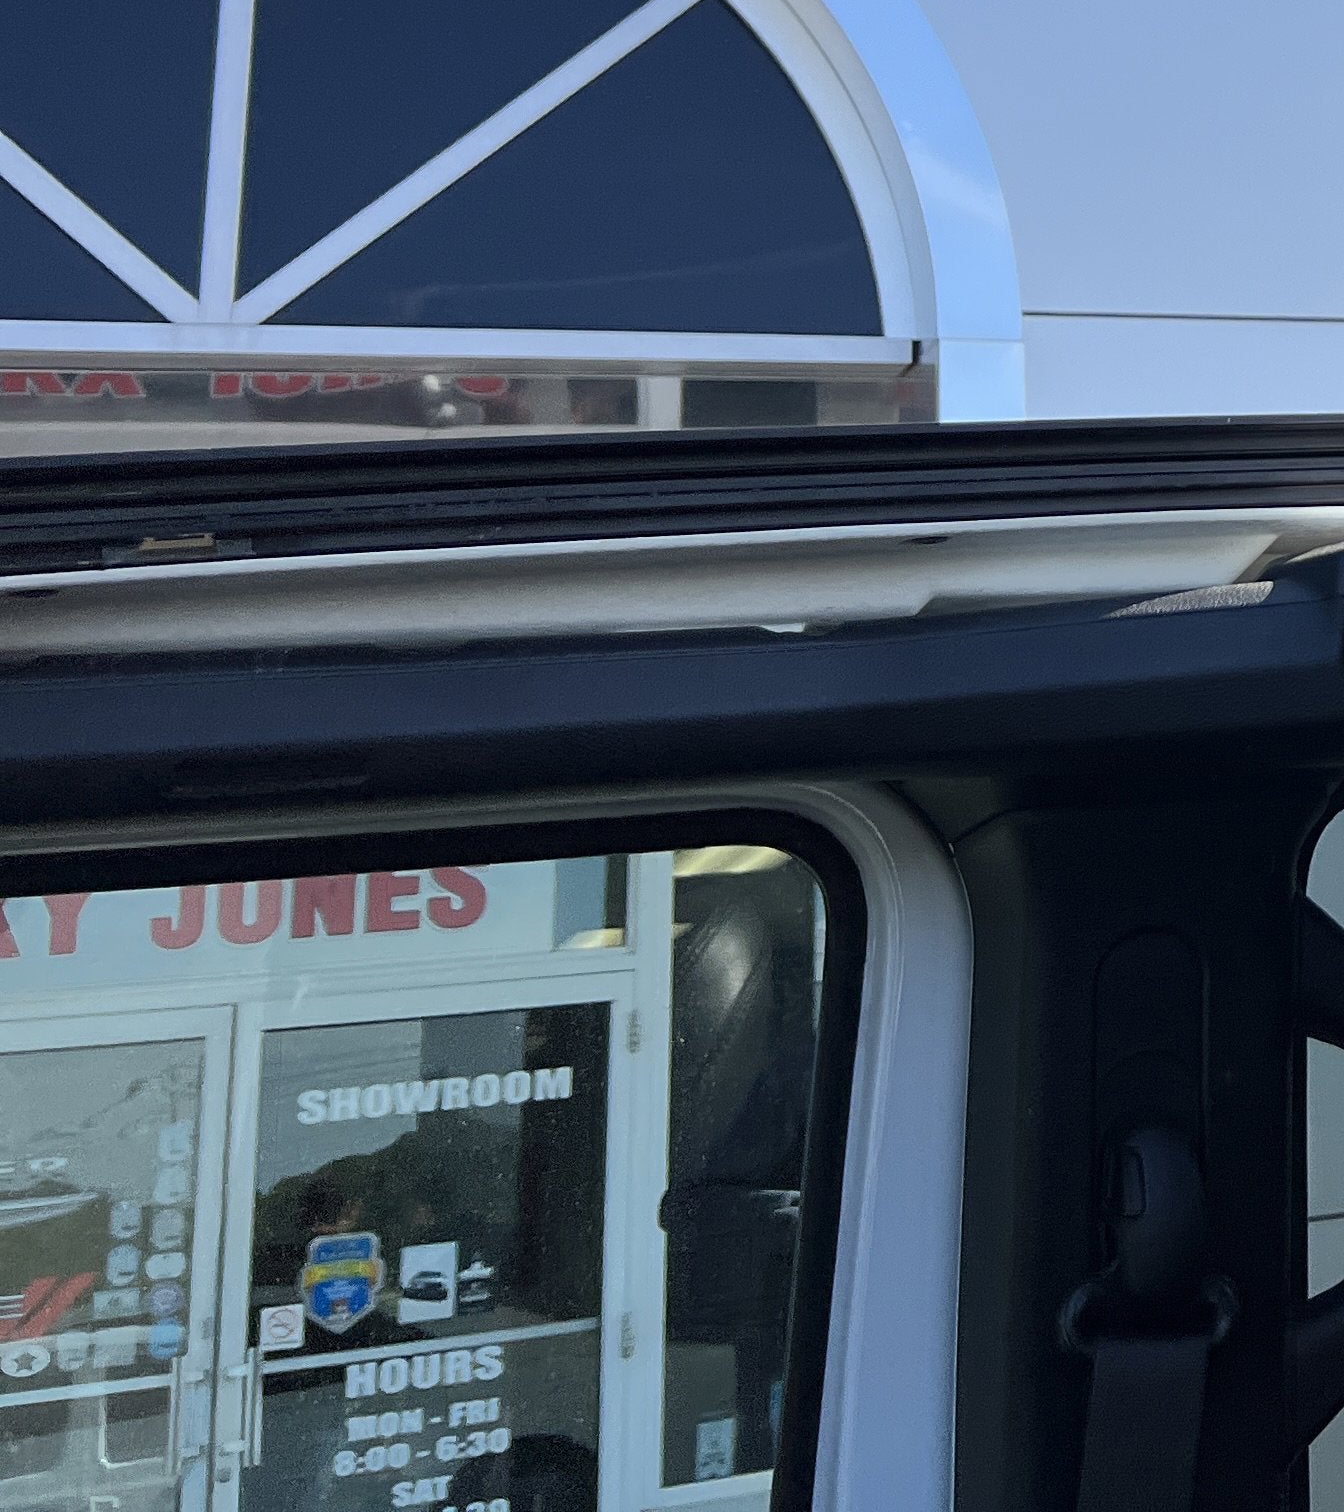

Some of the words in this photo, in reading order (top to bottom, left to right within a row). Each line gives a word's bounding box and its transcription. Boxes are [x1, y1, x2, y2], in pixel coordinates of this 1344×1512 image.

[296, 1066, 573, 1125] SHOWROOM
[344, 1345, 505, 1398] HOURS
[449, 1397, 500, 1428] FRI
[435, 1428, 512, 1462] 6:30
[391, 1474, 454, 1508] SAT
